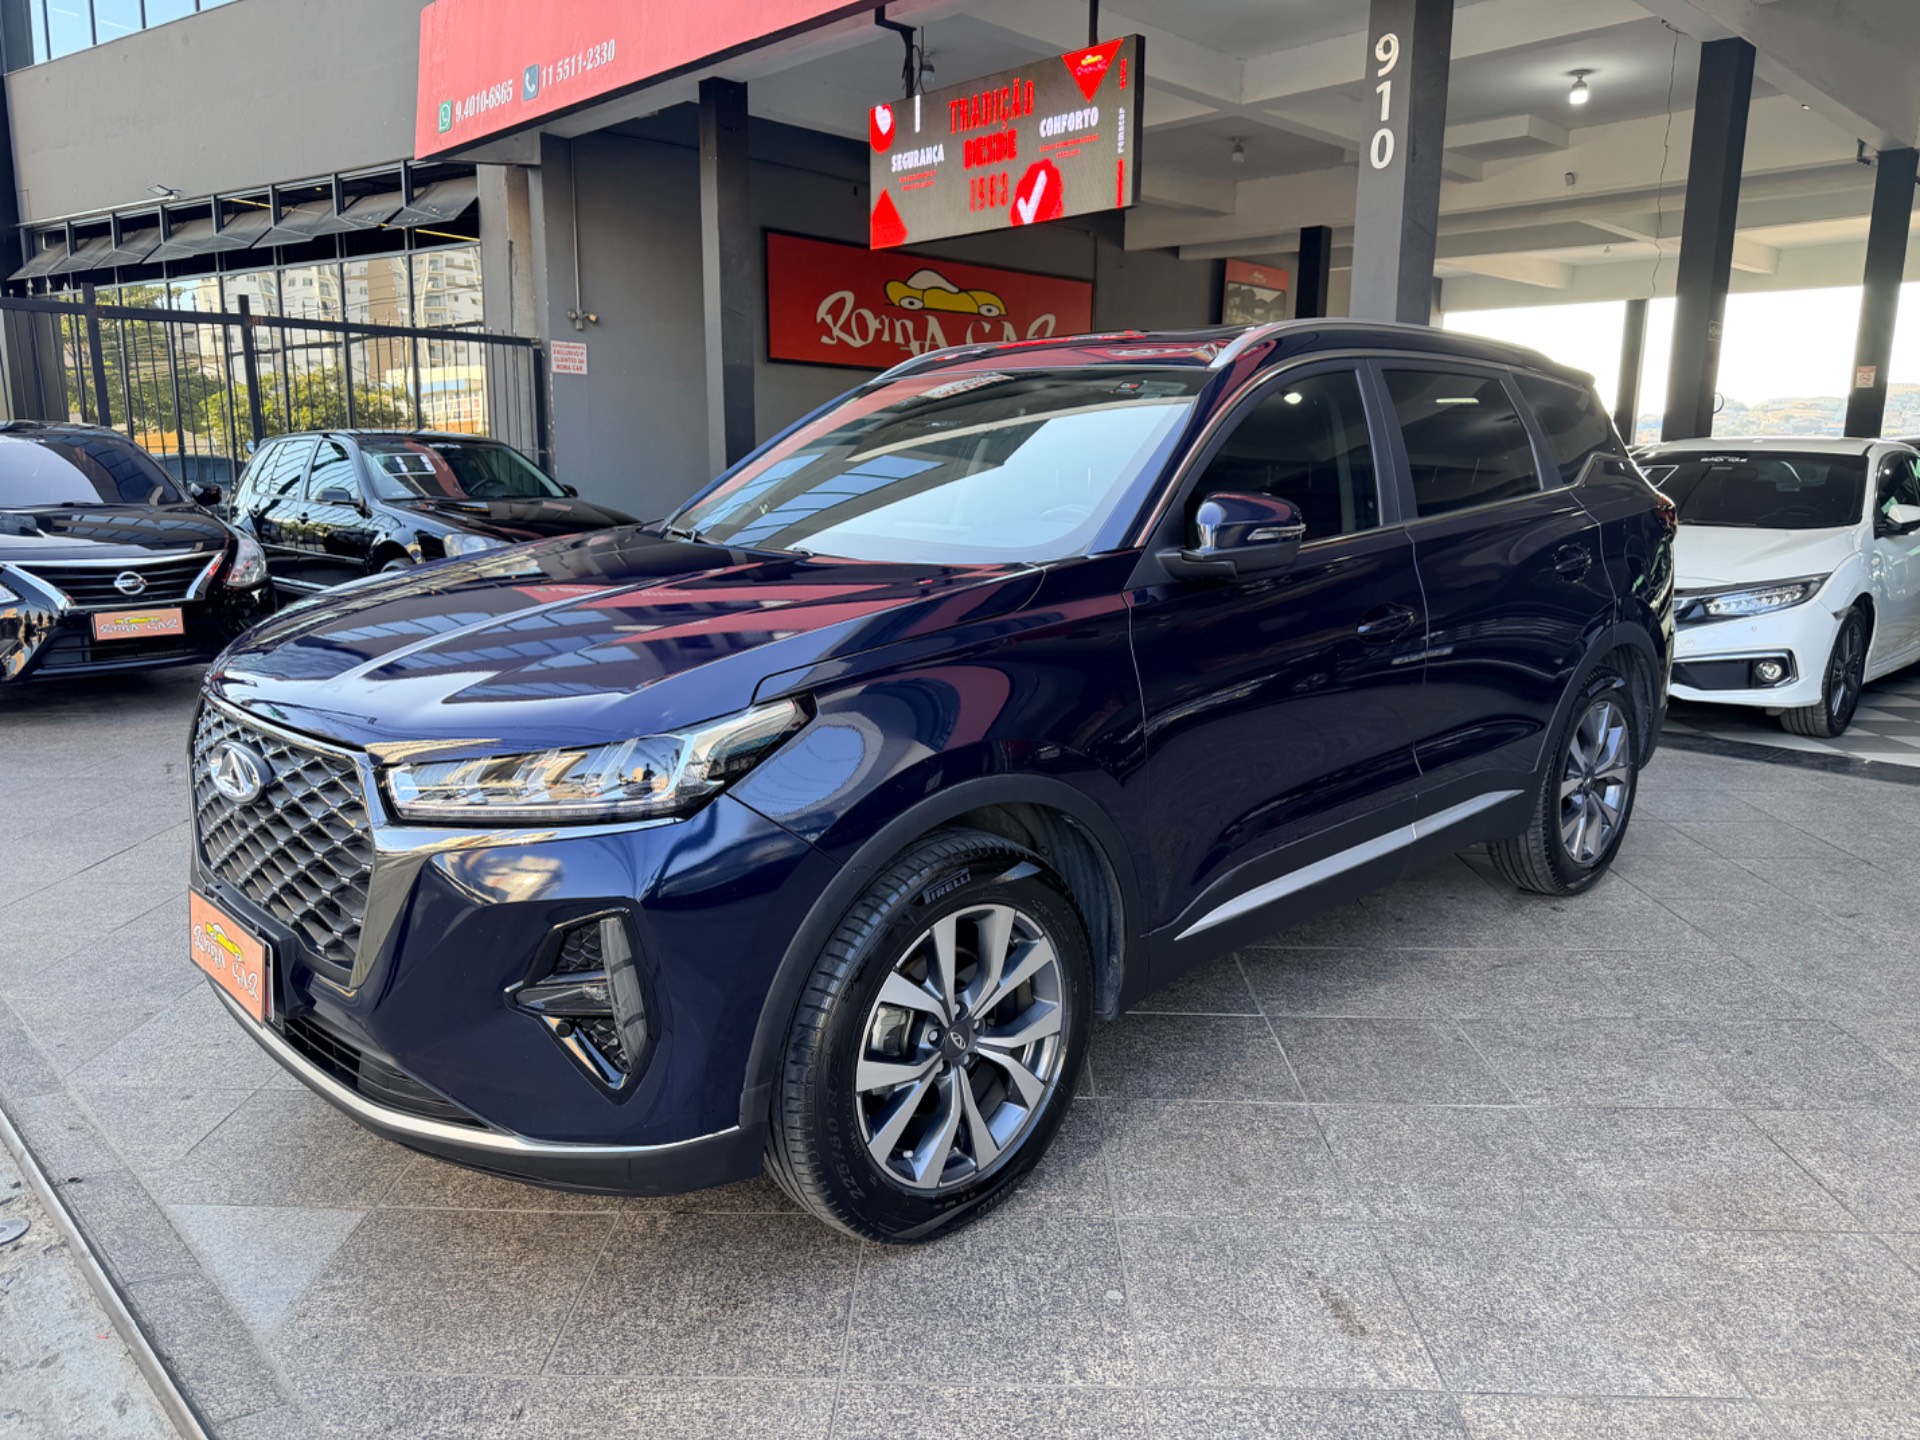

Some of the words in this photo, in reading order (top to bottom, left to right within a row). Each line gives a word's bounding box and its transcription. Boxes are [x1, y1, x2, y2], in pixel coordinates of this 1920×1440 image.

[542, 65, 554, 88] 11
[556, 38, 616, 82] 5511-2330
[455, 79, 513, 123] 9.4010-6865
[949, 78, 1035, 135] TRADIÇÃO
[1039, 106, 1099, 138] CONFORTO
[1370, 33, 1399, 169] 910
[891, 143, 945, 173] SEGURANÇA
[963, 128, 1017, 170] DESDE
[923, 867, 972, 904] PIRELLI
